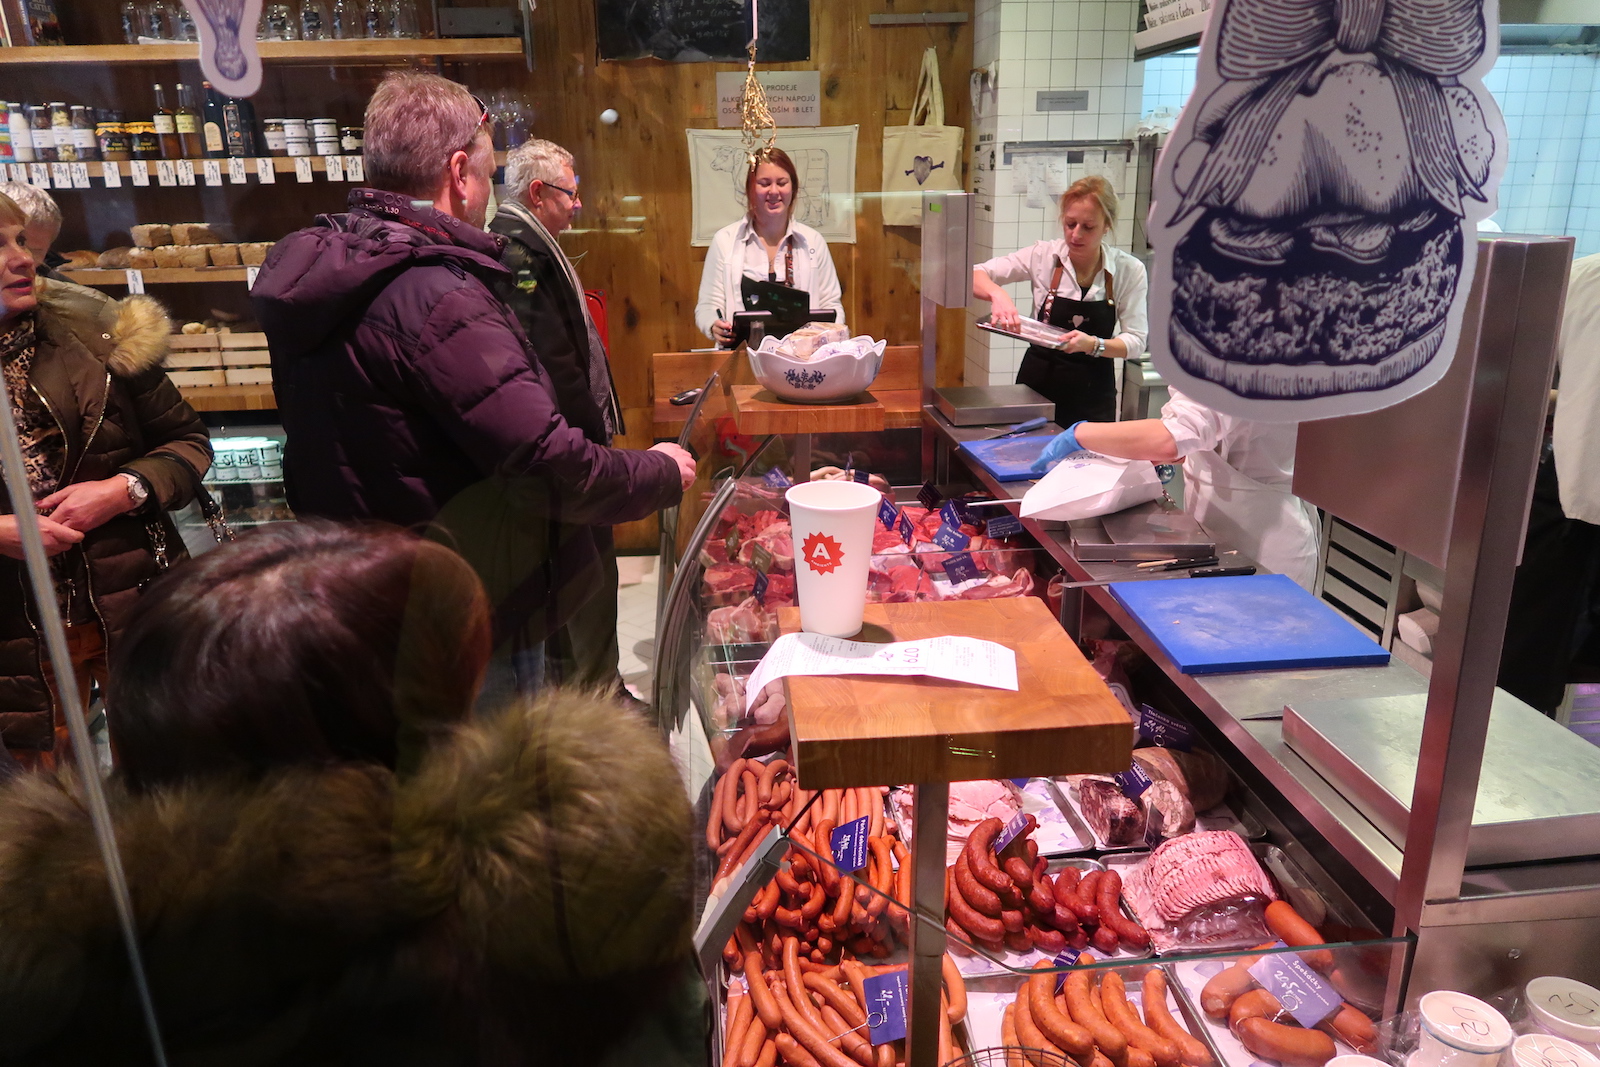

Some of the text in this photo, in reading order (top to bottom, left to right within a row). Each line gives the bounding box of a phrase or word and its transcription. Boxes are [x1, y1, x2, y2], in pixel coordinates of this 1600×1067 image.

[29, 2, 52, 12] CATTLE
[786, 94, 815, 102] NÁPOJŮ
[812, 542, 831, 560] A
[903, 647, 919, 664] 079
[1292, 960, 1323, 990] Špekáčky
